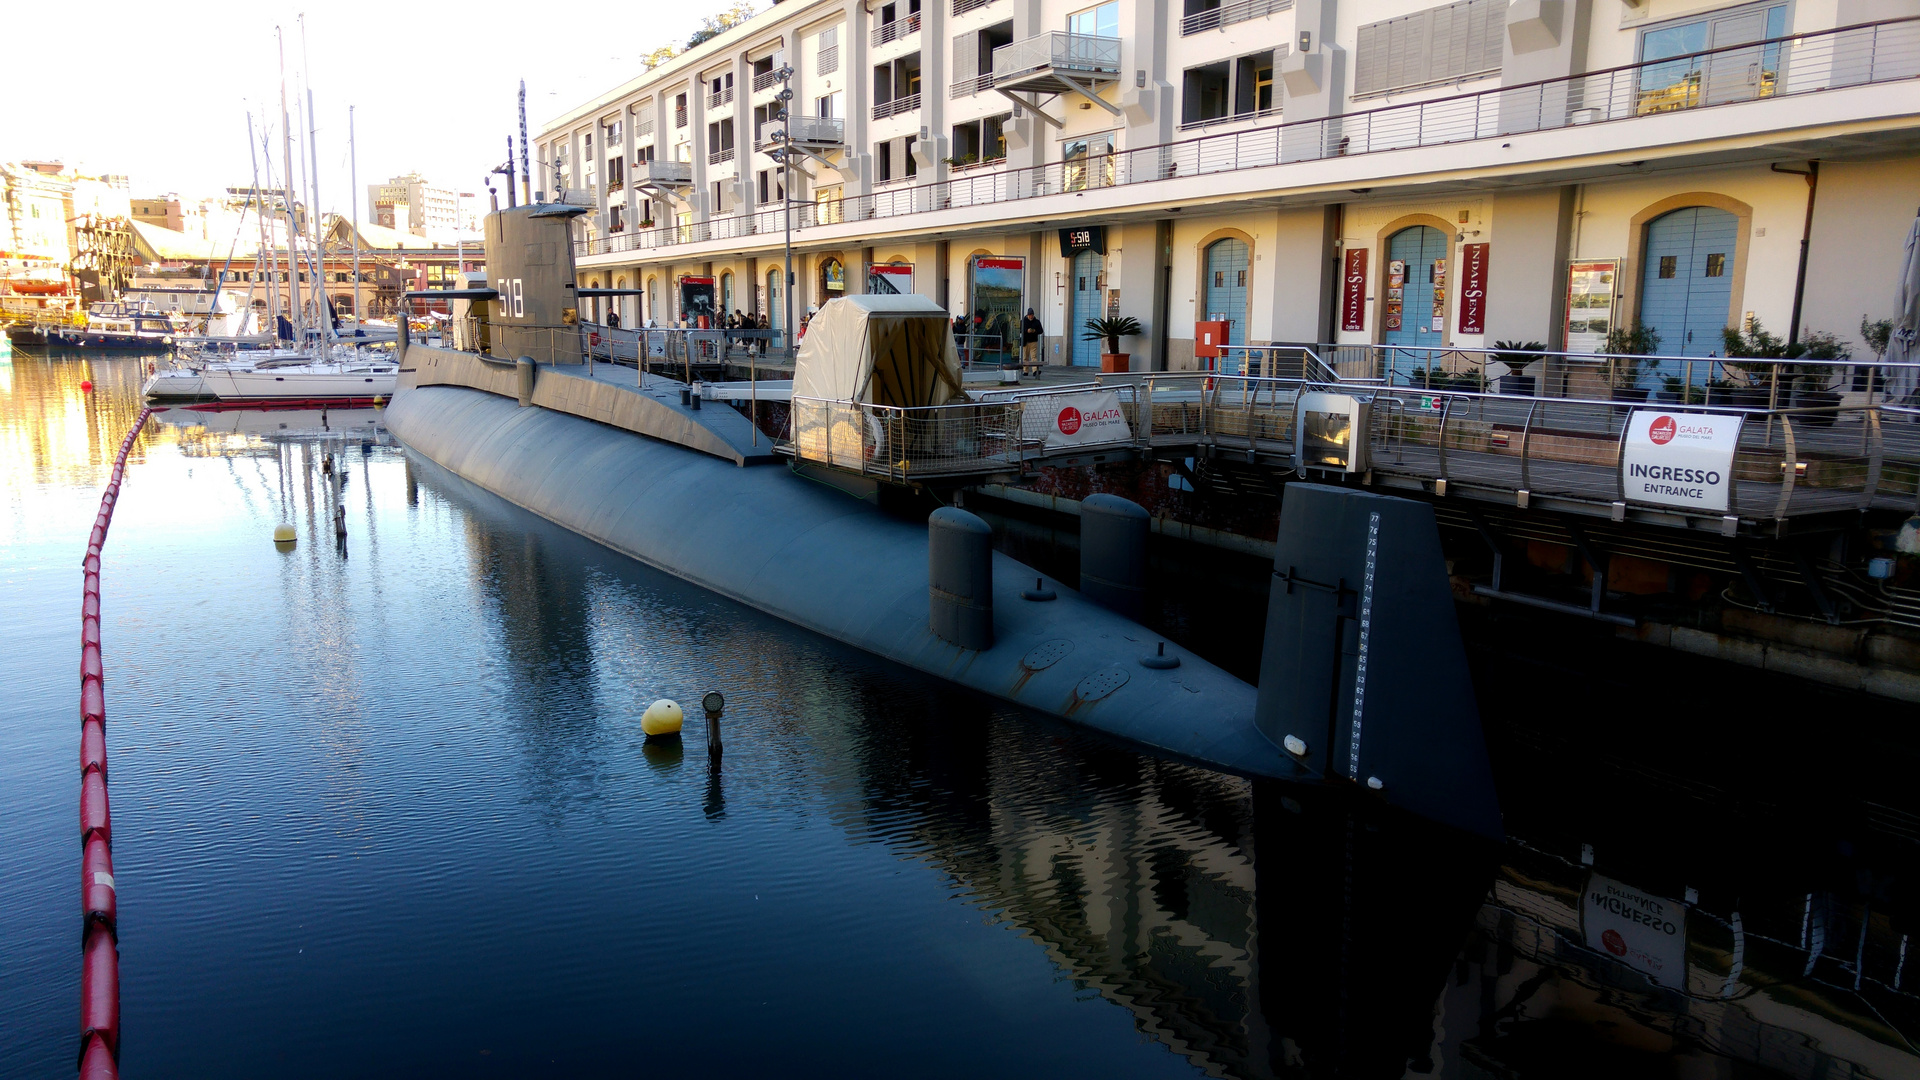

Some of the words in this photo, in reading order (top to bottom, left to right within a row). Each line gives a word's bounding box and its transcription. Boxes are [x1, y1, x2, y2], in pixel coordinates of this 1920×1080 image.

[1070, 230, 1090, 244] S-518
[1348, 250, 1363, 324] INDARSENA
[1464, 244, 1482, 326] INDARSENA
[498, 278, 524, 318] 518
[1082, 410, 1120, 422] GALATA
[1680, 426, 1714, 434] GALATA
[1630, 464, 1720, 485] INGRESSO
[1644, 483, 1703, 498] ENTRANCE
